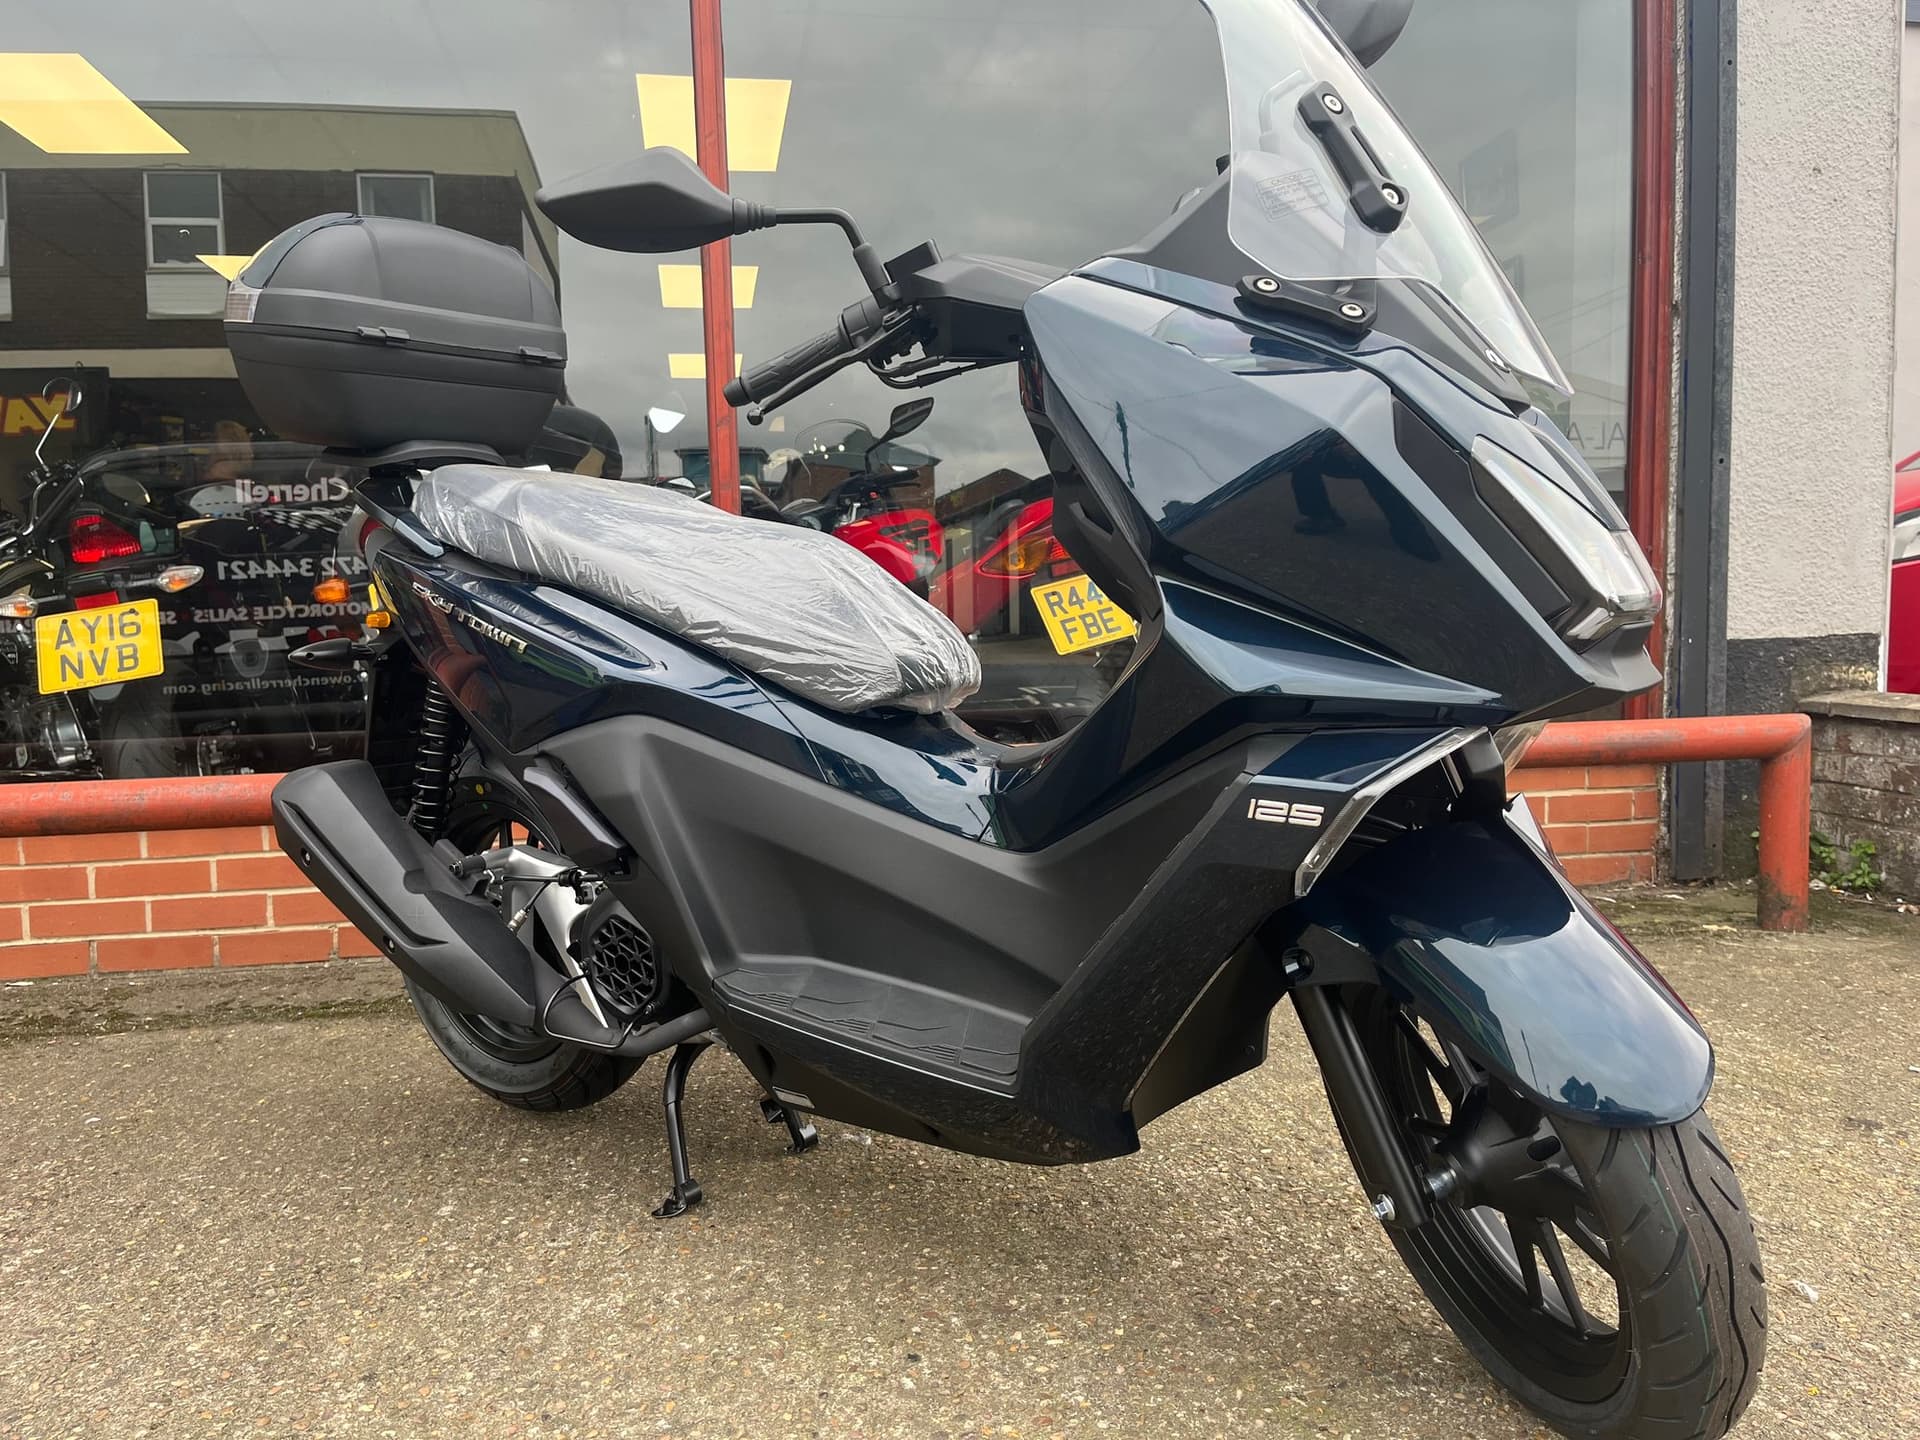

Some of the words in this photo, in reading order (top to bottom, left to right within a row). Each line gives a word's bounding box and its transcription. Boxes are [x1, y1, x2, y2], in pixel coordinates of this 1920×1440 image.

[55, 608, 142, 650] AY16
[1060, 606, 1122, 645] FBE
[60, 643, 140, 682] NVB
[1247, 798, 1325, 827] 125
